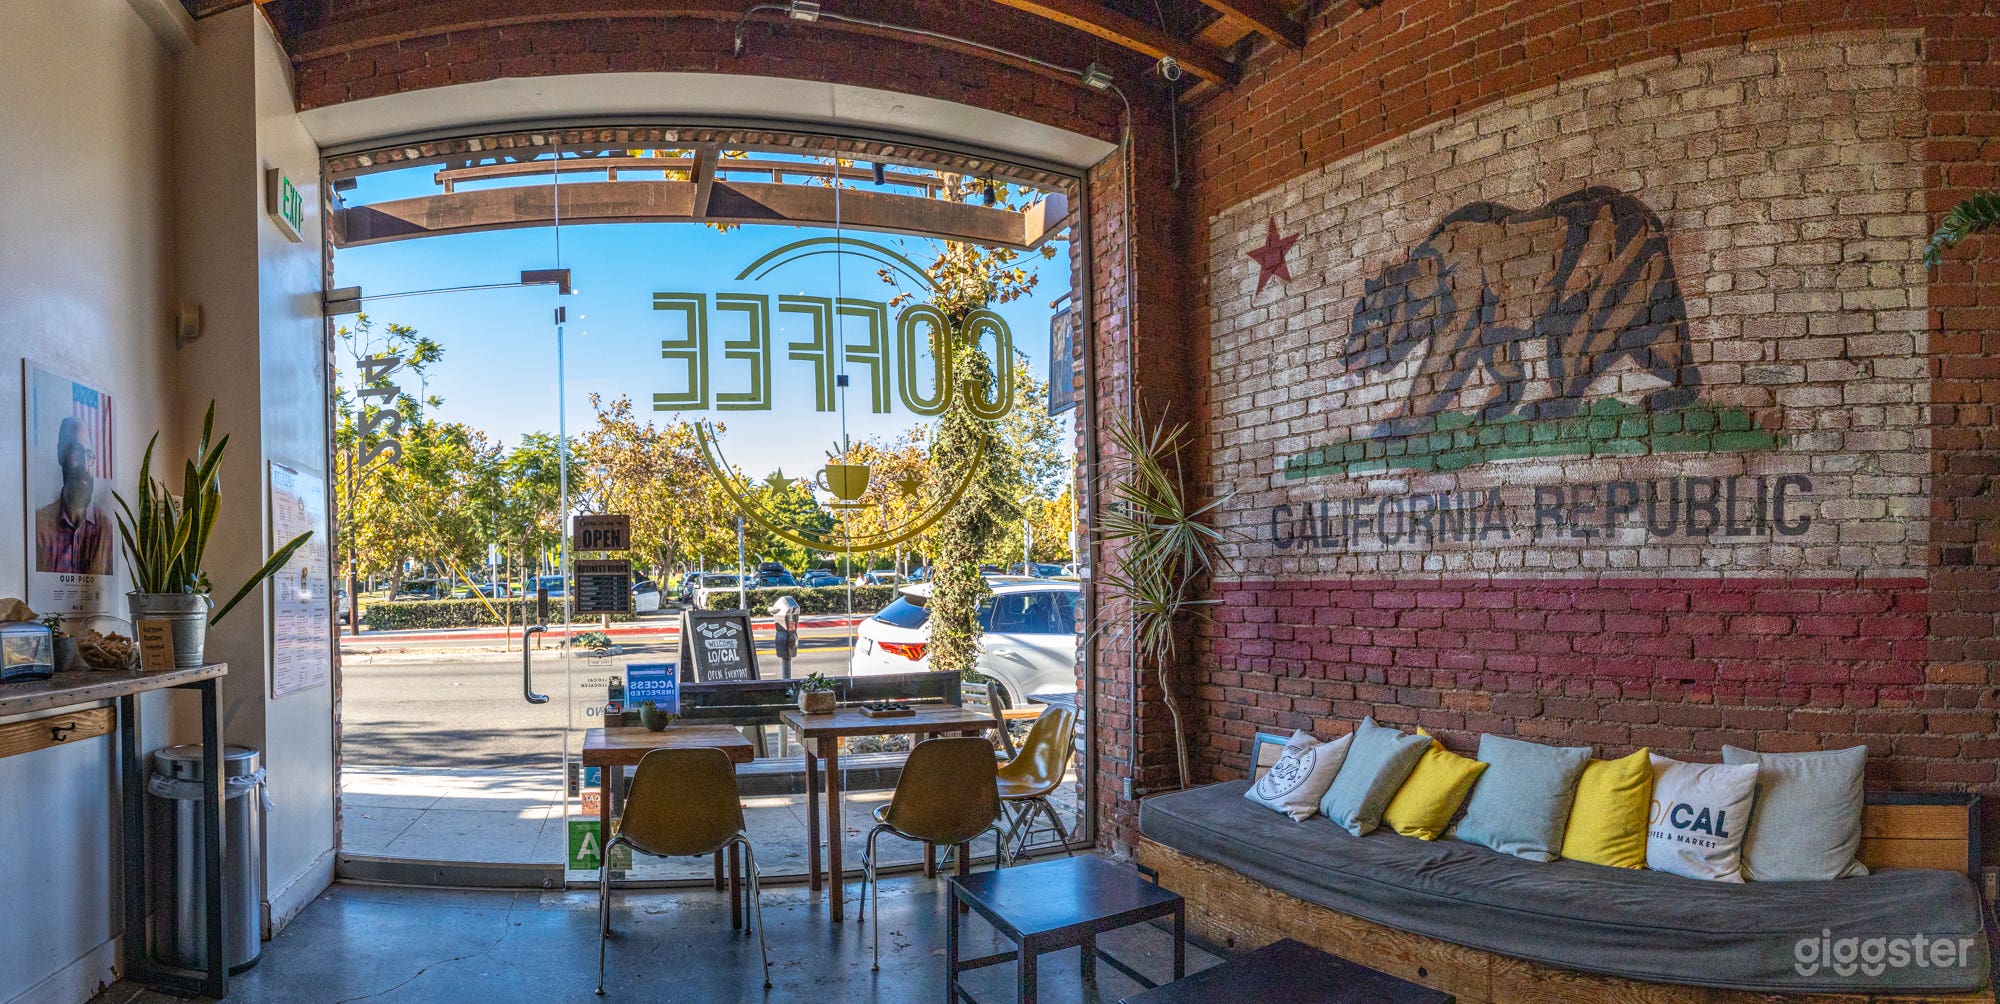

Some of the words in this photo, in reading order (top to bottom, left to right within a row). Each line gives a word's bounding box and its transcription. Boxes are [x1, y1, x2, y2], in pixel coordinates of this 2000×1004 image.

[283, 176, 303, 233] EXIT
[1271, 485, 1511, 549] CALIFORNIA
[1534, 475, 1813, 538] REPUBLIC
[583, 529, 621, 548] OPEN
[577, 565, 607, 573] BUSINESS
[608, 565, 628, 573] HOURS
[708, 640, 735, 648] WELCOME
[708, 649, 740, 663] LO/CAL
[707, 669, 722, 680] OPEN
[1677, 834, 1717, 849] MARKET
